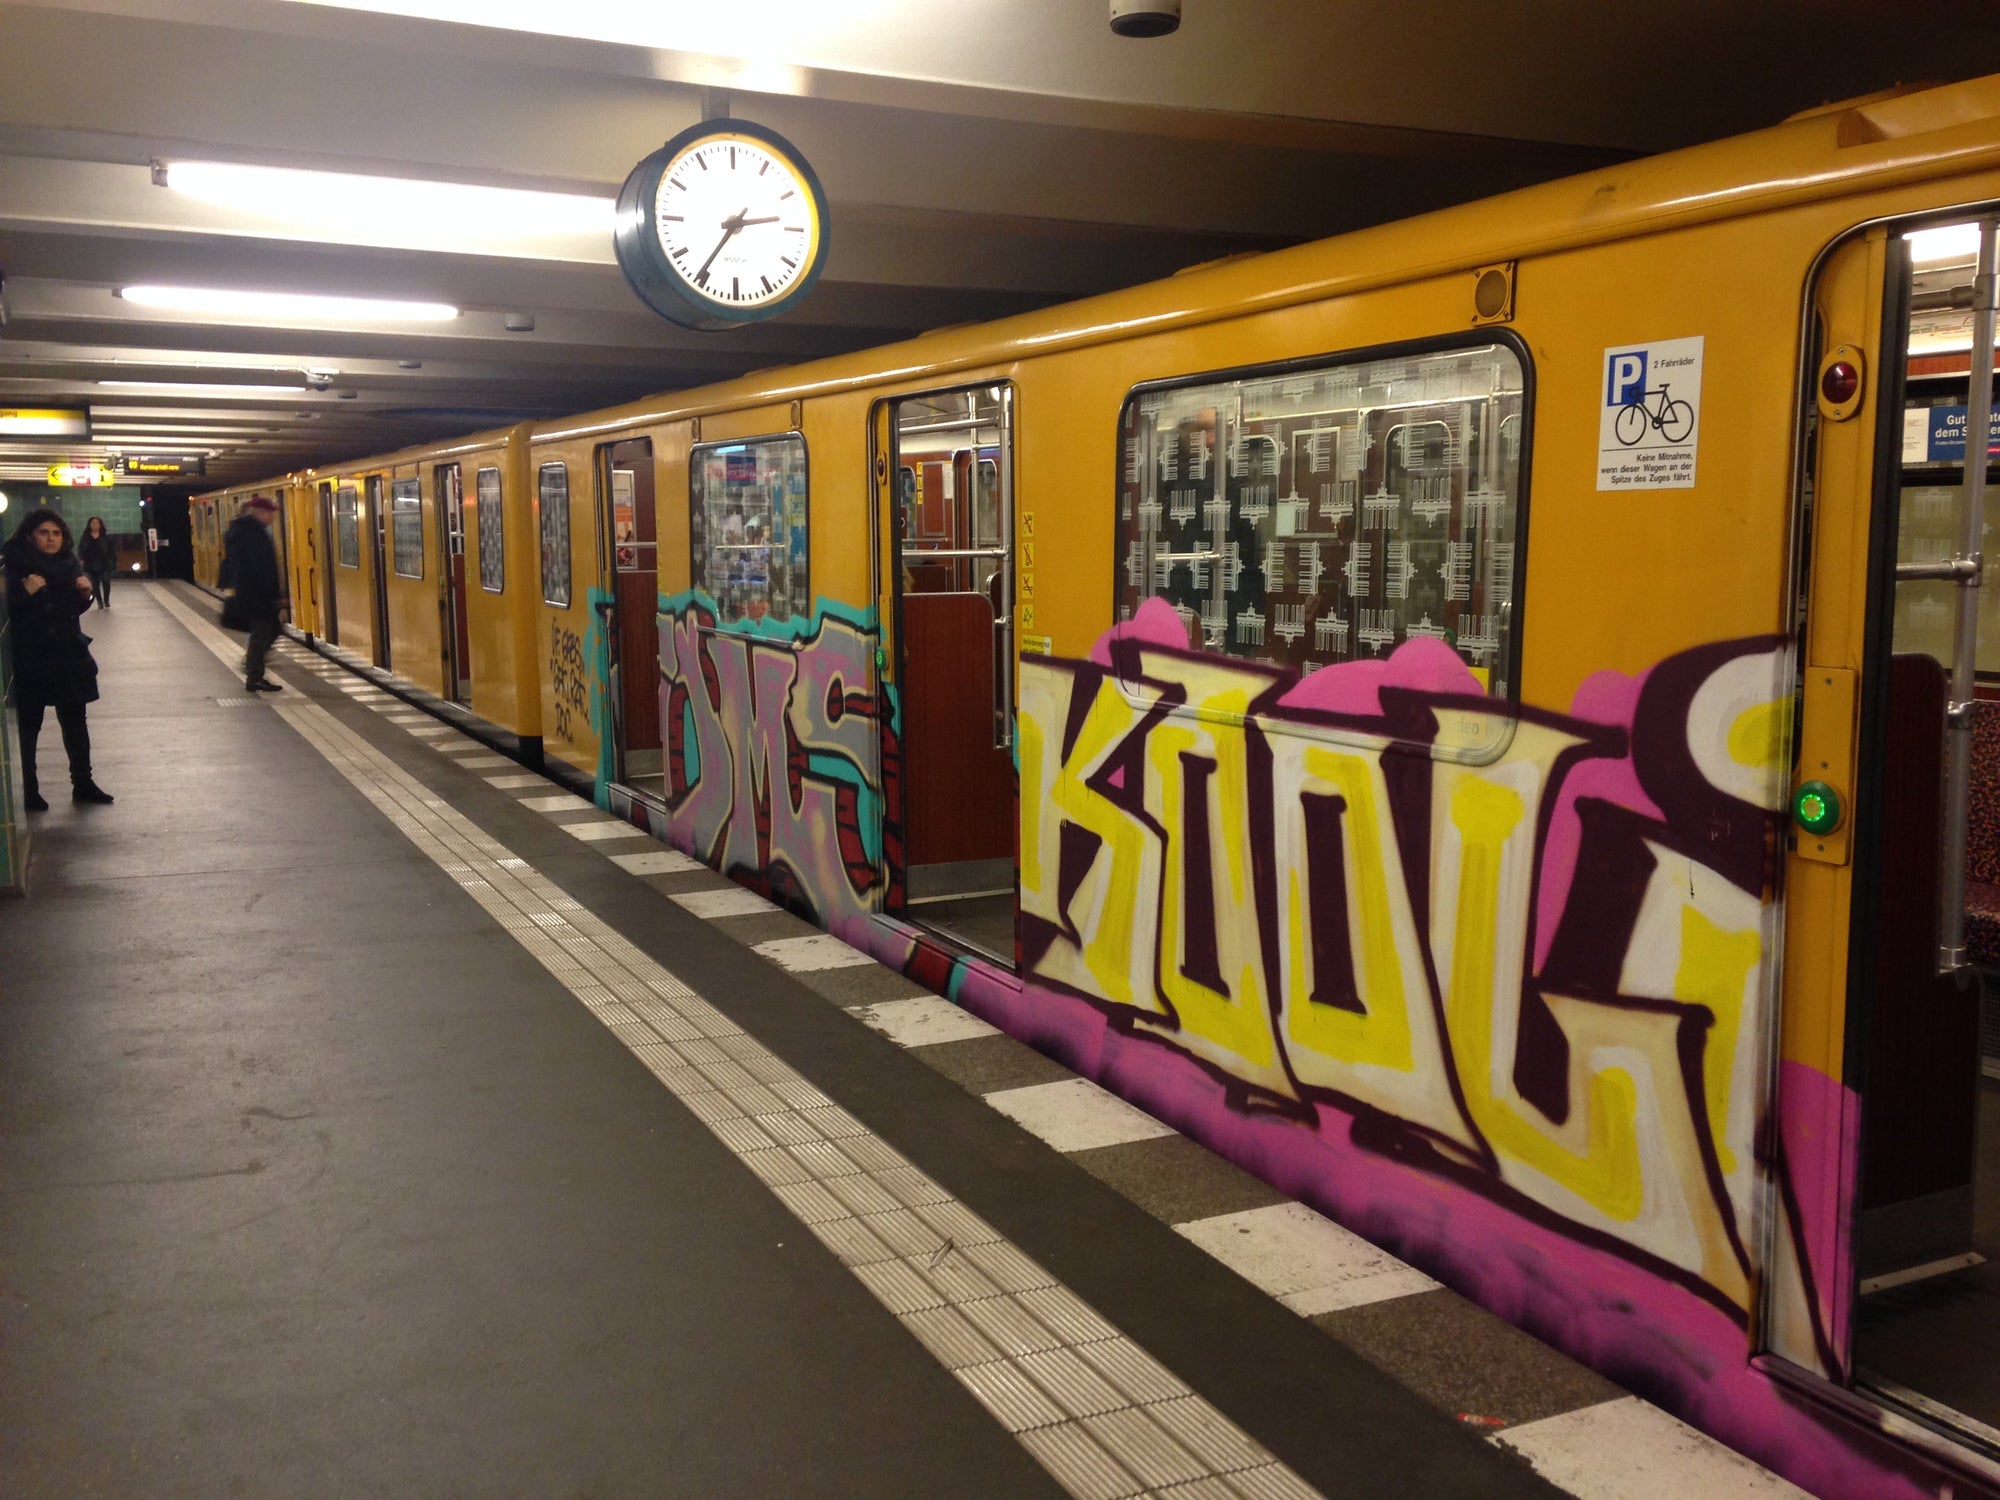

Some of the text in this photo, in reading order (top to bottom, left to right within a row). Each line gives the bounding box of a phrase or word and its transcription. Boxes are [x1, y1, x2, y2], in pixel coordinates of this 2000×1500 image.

[1653, 357, 1695, 369] 2 Fahrräder
[1612, 355, 1642, 404] P
[1935, 427, 1959, 438] dem
[1636, 453, 1656, 462] Keine
[1620, 465, 1641, 473] dieser
[1643, 464, 1667, 474] Wagen
[1611, 475, 1632, 485] Spitze
[1649, 474, 1671, 484] Zuges
[1673, 473, 1691, 482] fährt.
